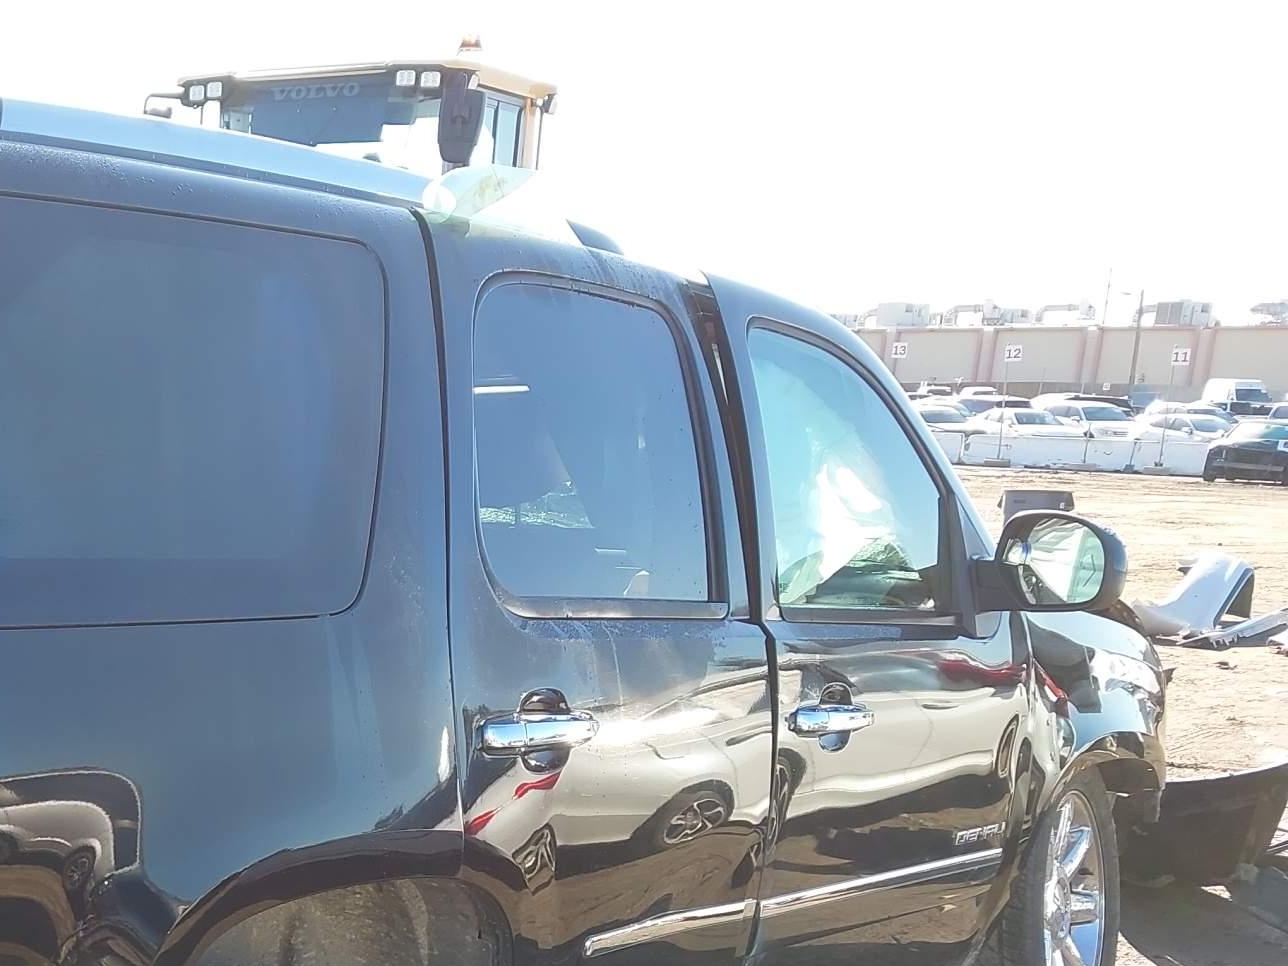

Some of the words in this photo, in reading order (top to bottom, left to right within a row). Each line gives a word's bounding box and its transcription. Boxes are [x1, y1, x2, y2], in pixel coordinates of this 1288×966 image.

[270, 82, 360, 101] VOLVO
[893, 345, 907, 356] 13
[1006, 348, 1021, 359] 12
[1172, 351, 1189, 362] 11
